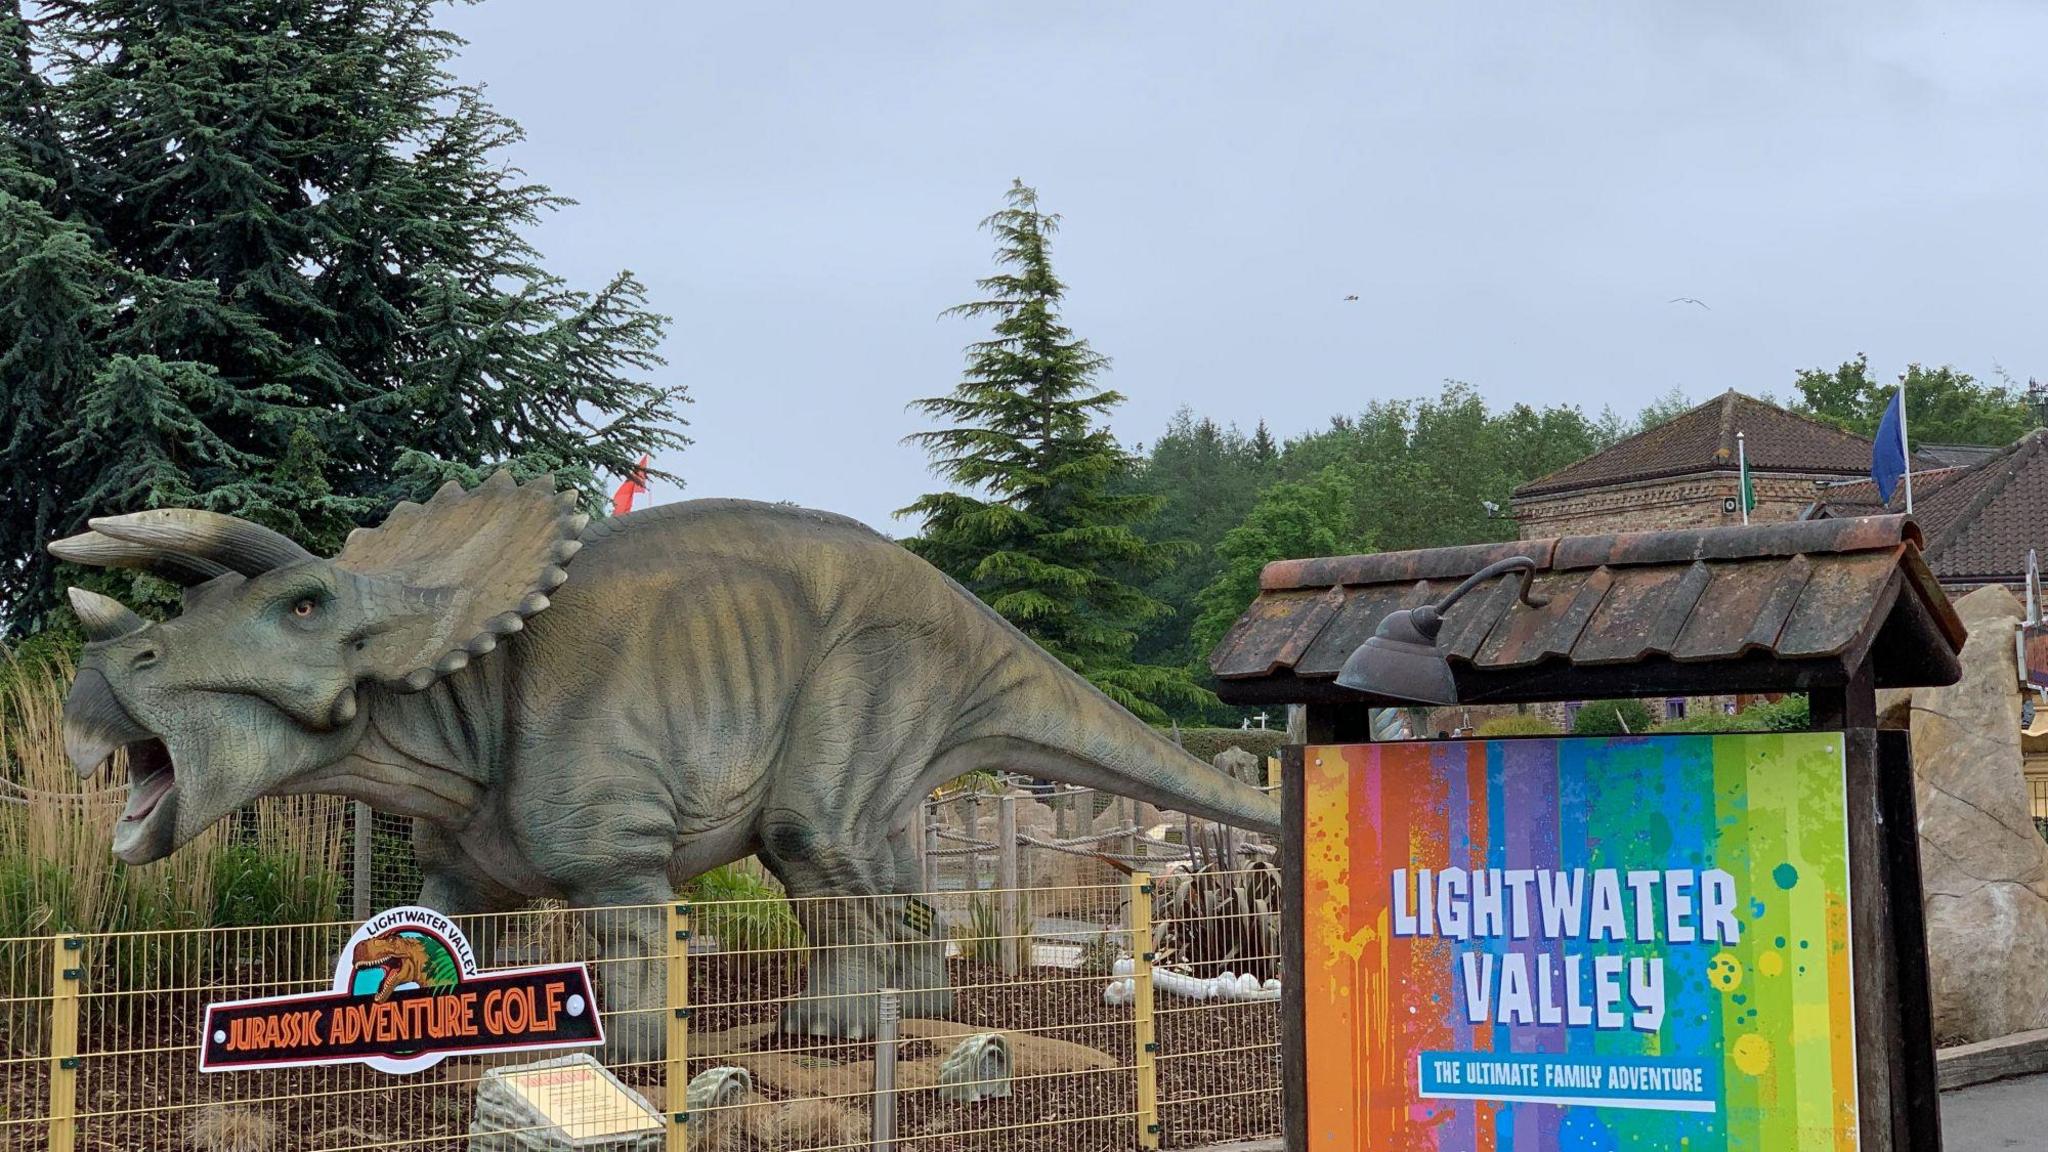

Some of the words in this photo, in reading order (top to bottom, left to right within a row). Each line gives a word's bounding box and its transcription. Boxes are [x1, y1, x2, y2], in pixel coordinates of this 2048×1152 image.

[1392, 866, 1741, 944] LIGHTWATER
[366, 911, 448, 936] LIGHTWATER
[447, 928, 476, 977] VALLEY
[226, 1009, 323, 1051] JURASSIC
[329, 992, 478, 1045] ADVENTURE
[483, 982, 566, 1035] GOLF
[1461, 952, 1666, 1031] VALLEY
[1433, 1060, 1461, 1085] THE
[1466, 1061, 1539, 1088] ULTIMATE
[1544, 1063, 1603, 1090] FAMILY
[1608, 1065, 1703, 1092] ADVENTURE
